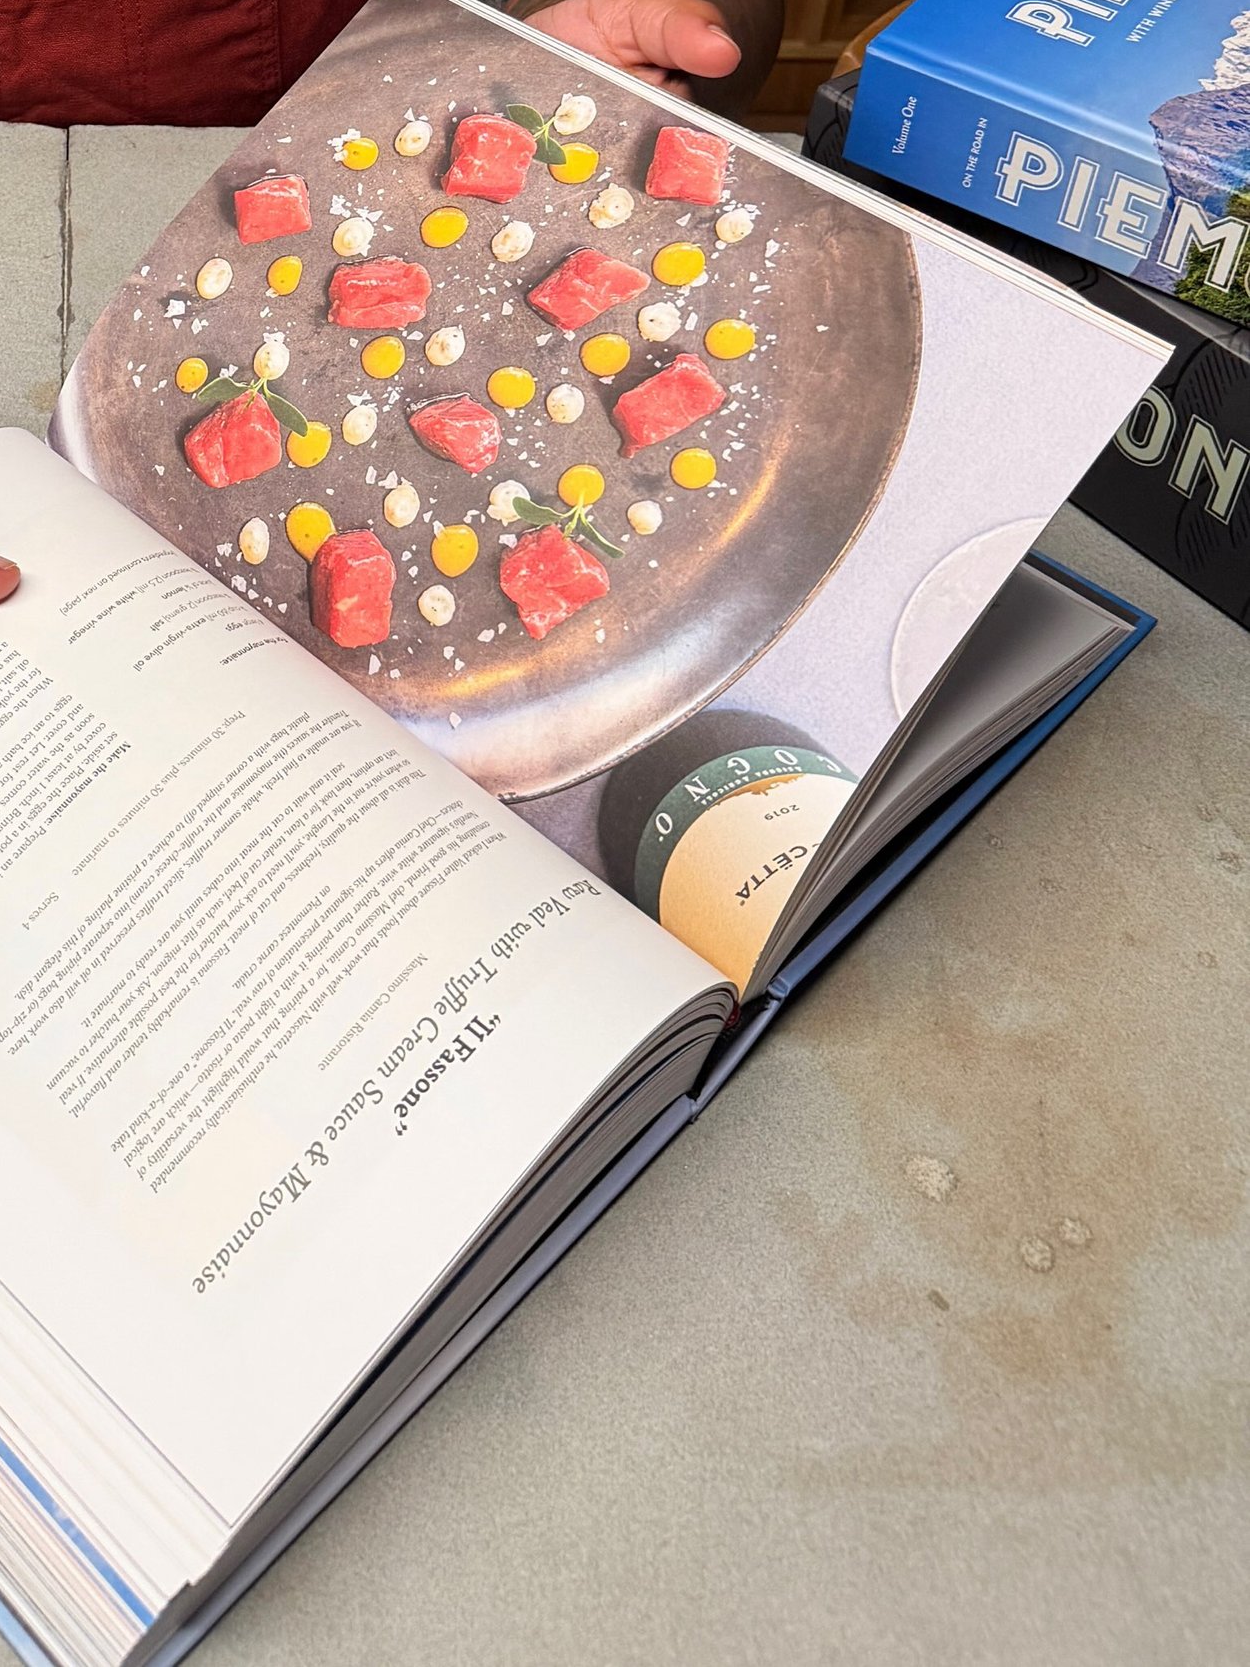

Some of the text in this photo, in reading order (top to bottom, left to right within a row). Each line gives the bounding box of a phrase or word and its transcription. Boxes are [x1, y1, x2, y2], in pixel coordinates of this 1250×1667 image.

[1125, 18, 1156, 43] WITH
[892, 96, 918, 154] Volume One
[962, 117, 988, 188] ON THE ROAD IN
[995, 130, 1250, 293] PIEM
[1112, 384, 1250, 526] ON
[68, 590, 137, 644] white wine vinegar
[26, 677, 53, 698] When
[12, 698, 28, 711] the
[286, 711, 310, 730] plastic
[83, 722, 106, 744] cover
[103, 731, 117, 744] set
[211, 726, 225, 739] 30
[269, 728, 289, 742] bags
[63, 752, 74, 763] at
[72, 742, 87, 754] by
[105, 740, 131, 763] Make
[253, 741, 271, 757] with
[43, 762, 67, 782] least
[59, 765, 84, 788] Place
[91, 762, 107, 777] the
[160, 764, 179, 784] plus
[224, 760, 247, 784] corner
[45, 787, 61, 801] the
[149, 783, 164, 797] 30
[196, 781, 225, 812] snipped
[26, 801, 47, 821] eggs
[117, 794, 150, 827] minutes
[183, 808, 197, 824] off)
[764, 803, 800, 821] 2019
[17, 820, 30, 830] in
[108, 827, 119, 837] to
[175, 821, 185, 831] to
[12, 825, 46, 858] Prepare
[147, 830, 175, 860] achieve
[0, 858, 13, 870] an
[71, 837, 109, 875] marinate
[112, 864, 141, 897] pristine
[734, 844, 808, 903] CËTTA
[318, 885, 330, 897] on
[28, 891, 59, 921] Serves
[84, 893, 113, 925] plating
[278, 895, 322, 941] Piemontese
[76, 924, 86, 938] of
[61, 933, 78, 951] this
[256, 939, 278, 964] carne
[33, 949, 62, 982] elegant
[317, 952, 428, 1070] Massimo Camia Ristorante
[192, 879, 601, 1293] Raw Veal with Truffle Cream Sauce & Mayonnaise
